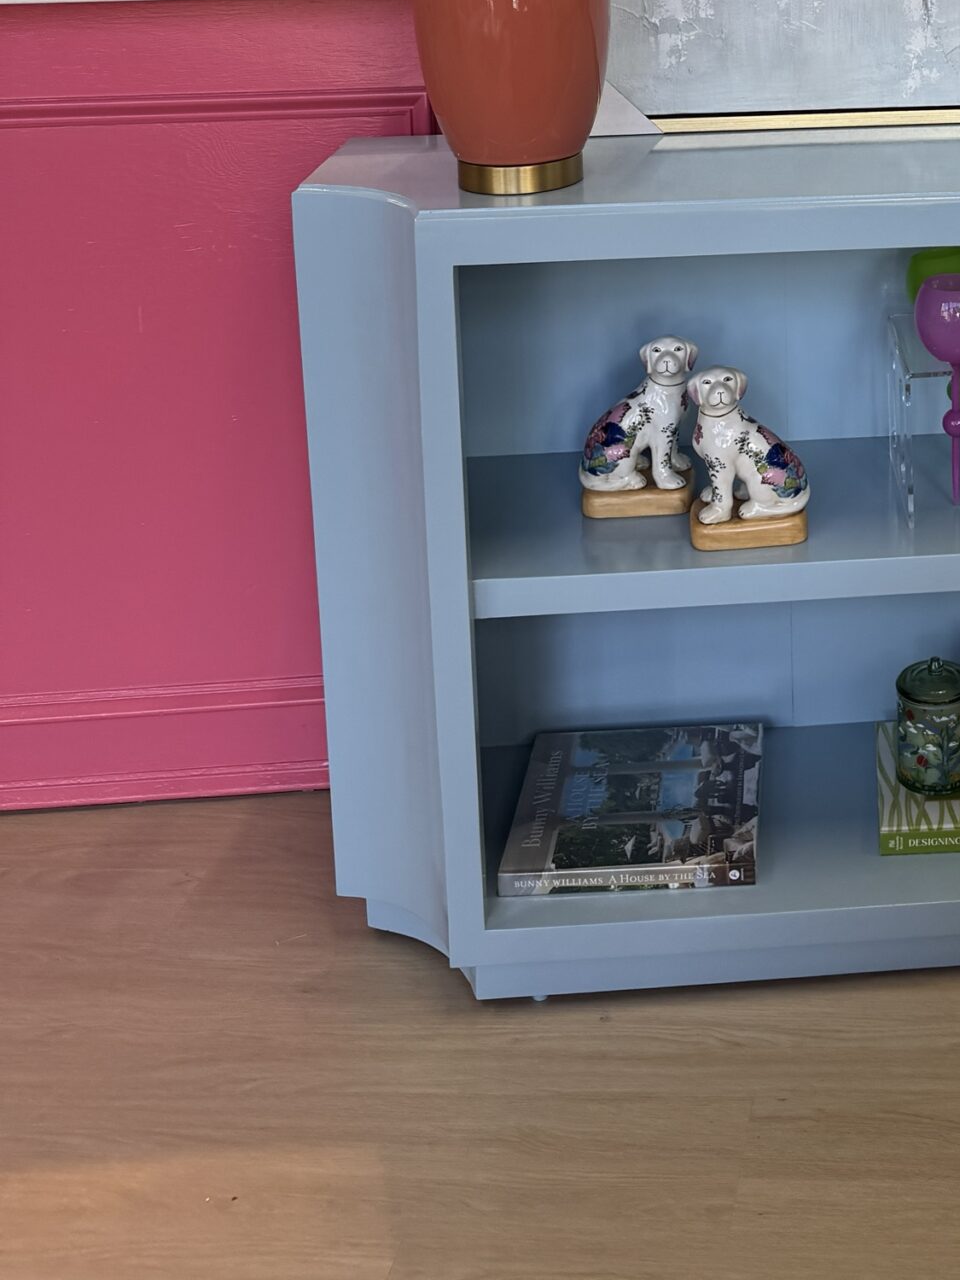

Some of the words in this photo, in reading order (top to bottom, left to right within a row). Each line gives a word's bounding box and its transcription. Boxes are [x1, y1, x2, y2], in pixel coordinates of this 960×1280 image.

[532, 750, 563, 806] Williams
[521, 807, 556, 848] Bunny
[514, 878, 550, 888] BUNNY
[552, 876, 604, 887] WILLIAMS
[609, 875, 618, 884] A
[620, 872, 656, 884] HOUSE
[658, 873, 671, 882] BY
[673, 871, 694, 881] THE
[696, 868, 717, 879] SEA
